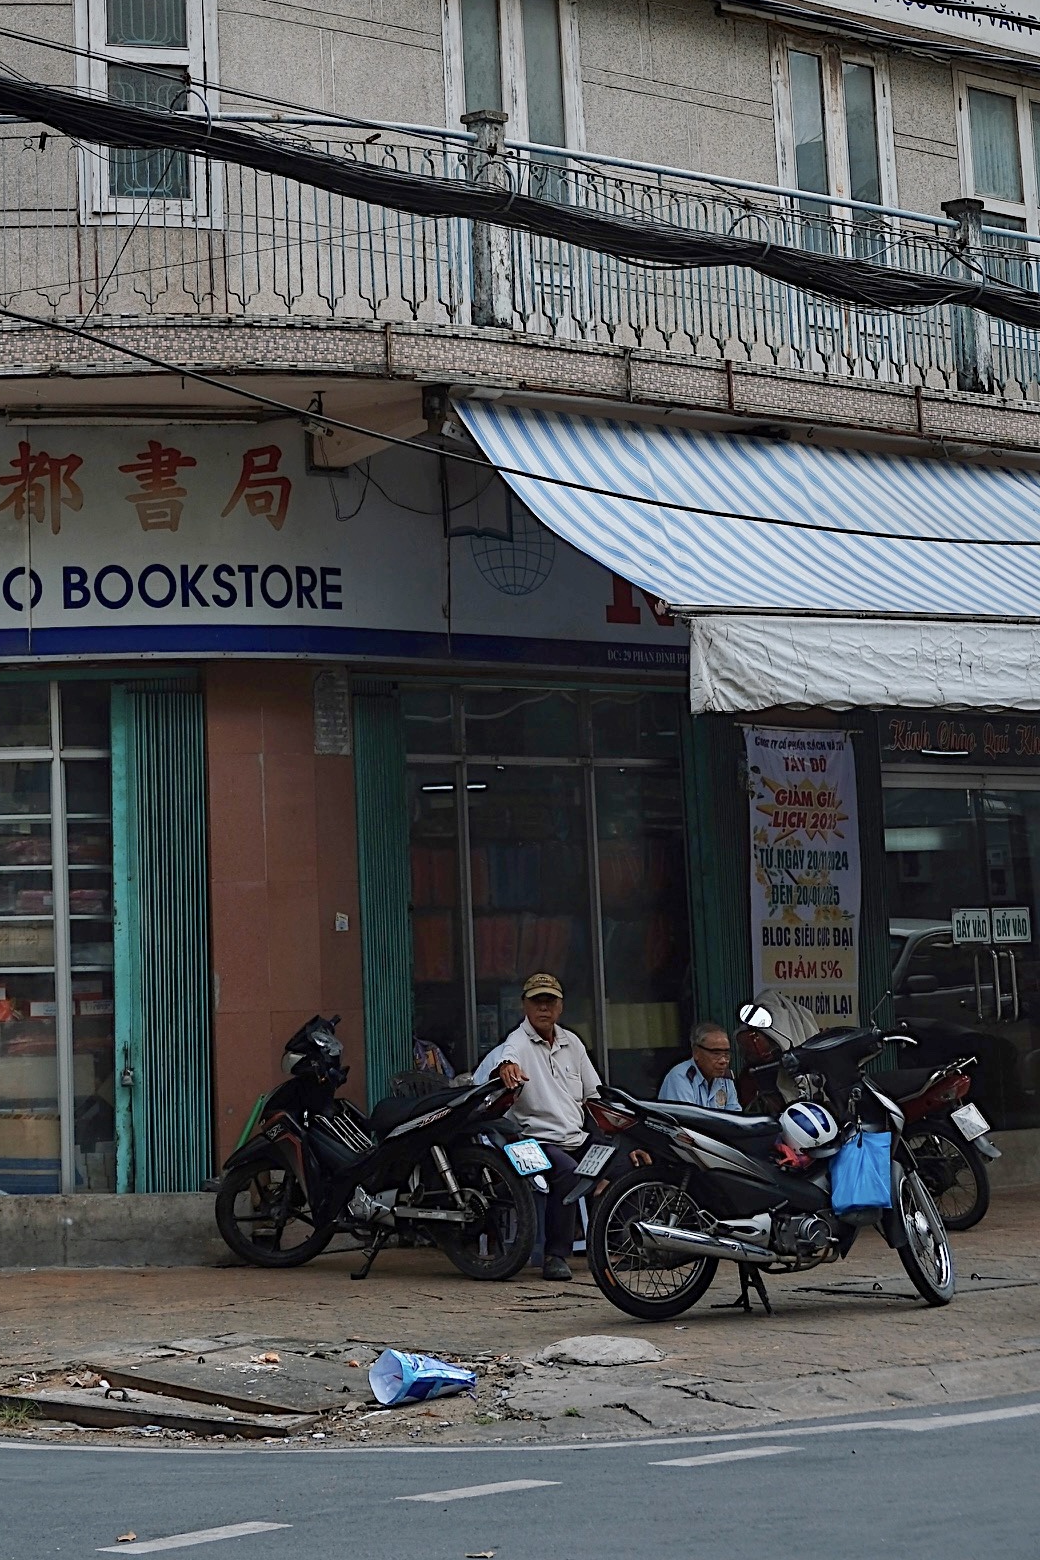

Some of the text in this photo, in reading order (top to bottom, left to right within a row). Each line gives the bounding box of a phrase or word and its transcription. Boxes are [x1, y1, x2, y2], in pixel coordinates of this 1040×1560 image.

[63, 563, 344, 611] BOOKSTORE
[774, 784, 814, 808] GIẢM
[772, 810, 808, 833] LỊCH
[762, 926, 791, 947] BLOC
[794, 923, 815, 947] SIÊU
[832, 926, 854, 951] ĐẠI
[774, 954, 843, 980] GIẢM 5%
[833, 994, 853, 1019] LẠI
